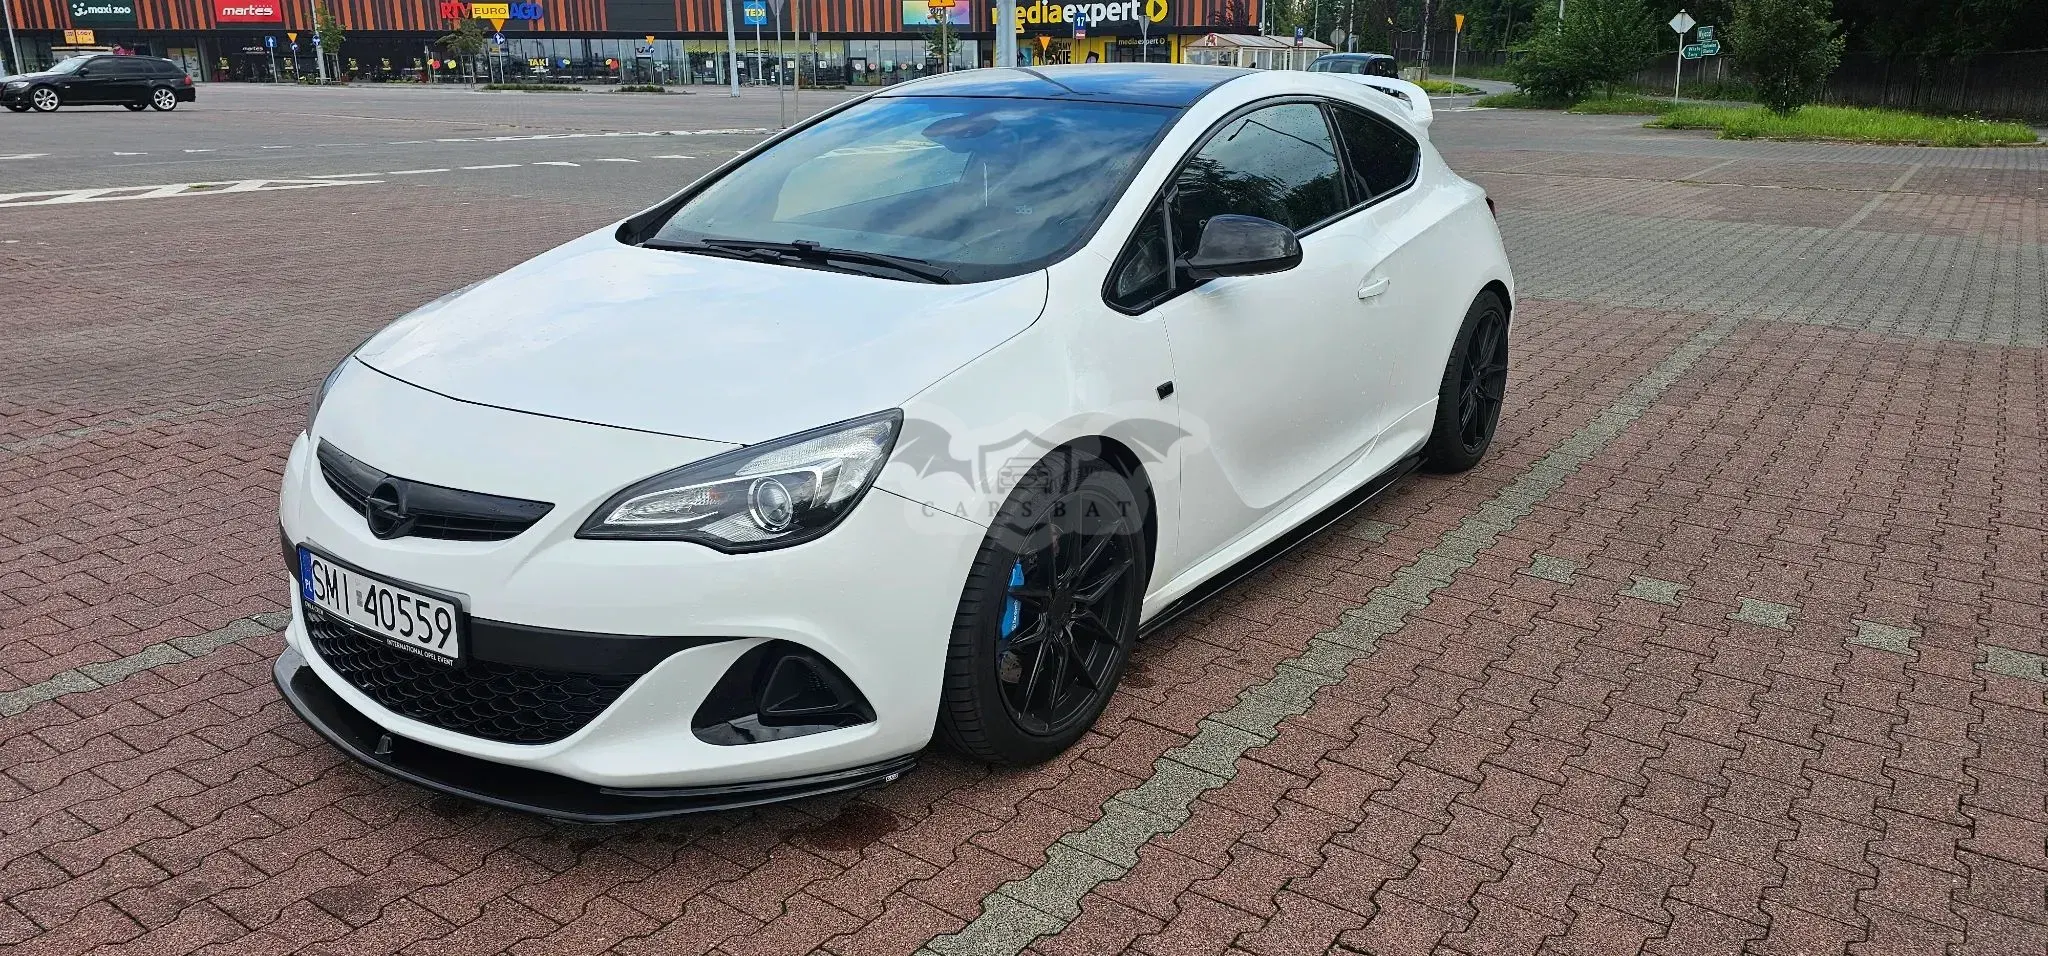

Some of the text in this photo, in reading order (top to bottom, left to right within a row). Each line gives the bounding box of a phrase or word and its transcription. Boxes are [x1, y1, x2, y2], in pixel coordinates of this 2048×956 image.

[87, 4, 131, 14] maxi zoo
[222, 4, 273, 16] martes
[440, 2, 543, 20] RTV EURO AGD
[1076, 16, 1085, 27] 17
[304, 578, 313, 593] PL
[312, 559, 451, 649] SMI 40559
[386, 638, 454, 667] INTERNATIONAL OPEL EVENT
